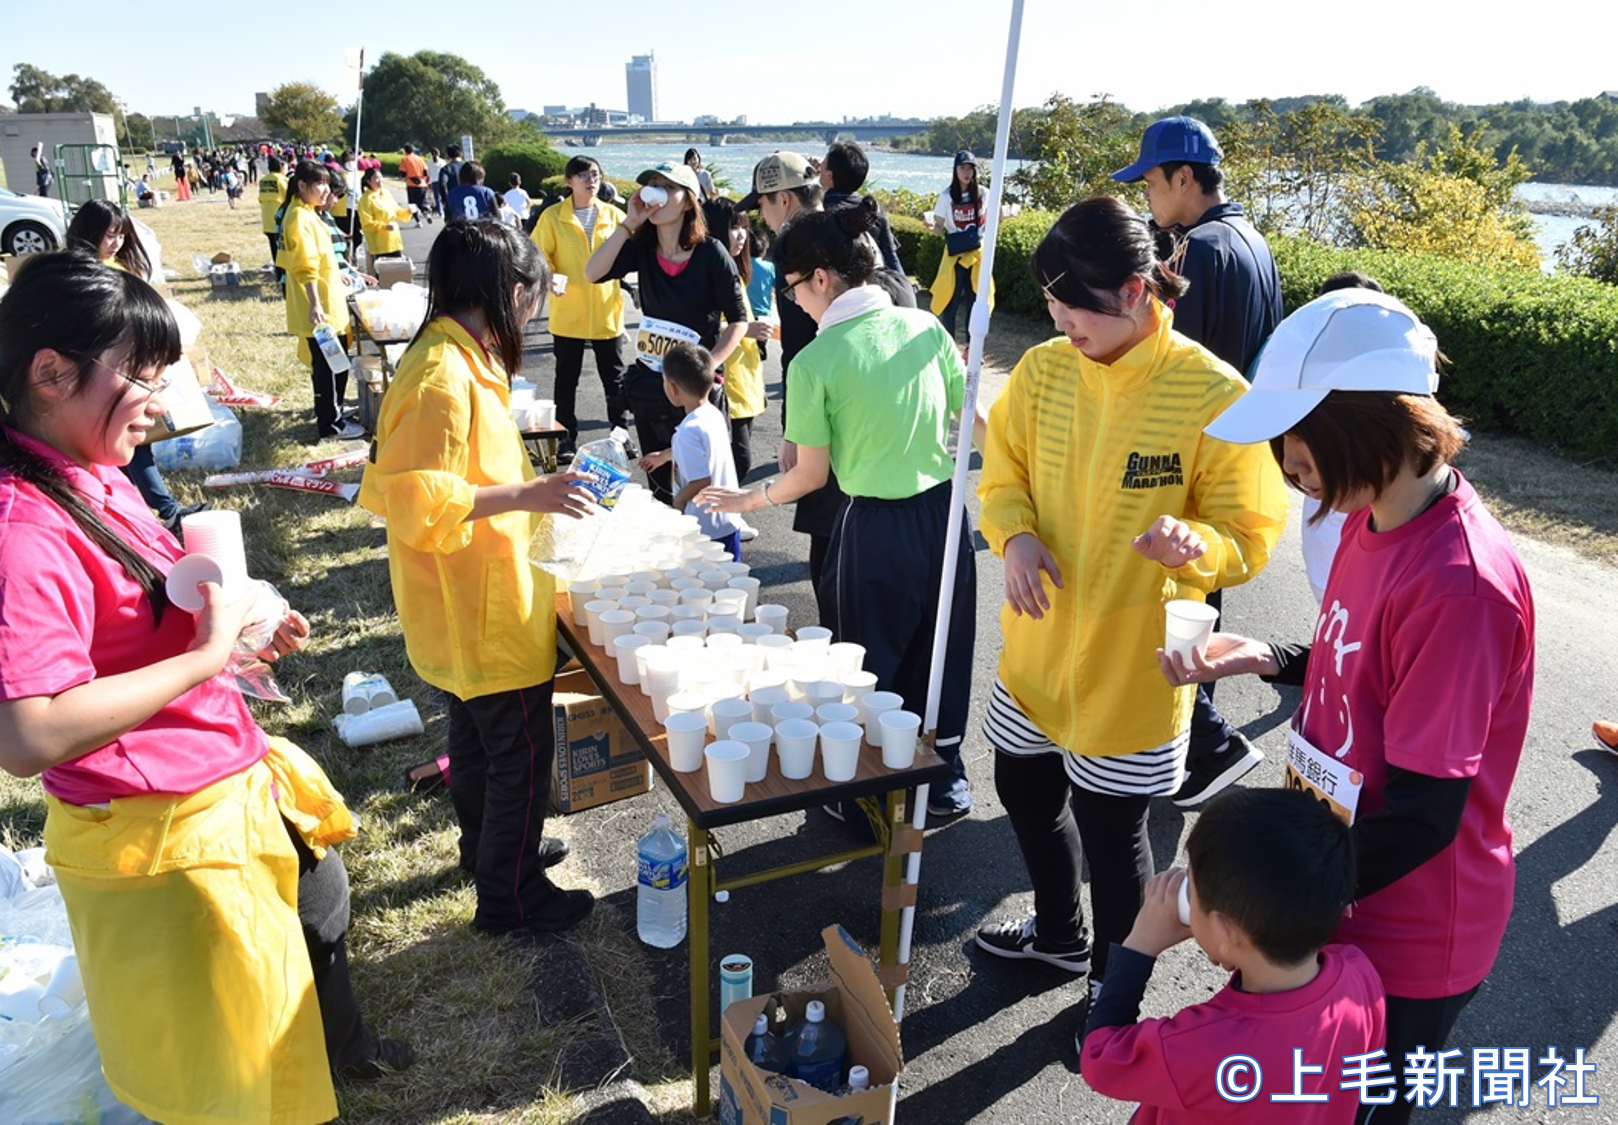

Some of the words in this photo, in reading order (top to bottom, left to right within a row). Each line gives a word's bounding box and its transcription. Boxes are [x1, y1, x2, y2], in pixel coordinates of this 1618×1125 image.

[464, 196, 479, 220] 8
[648, 333, 686, 355] 507
[1121, 474, 1184, 489] MARAHON
[557, 716, 566, 741] KIRIN
[558, 742, 567, 768] LOVES
[572, 744, 599, 757] KIRIN
[572, 752, 600, 765] LOVES
[572, 758, 607, 772] SPORTS
[560, 768, 569, 801] SPORTS
